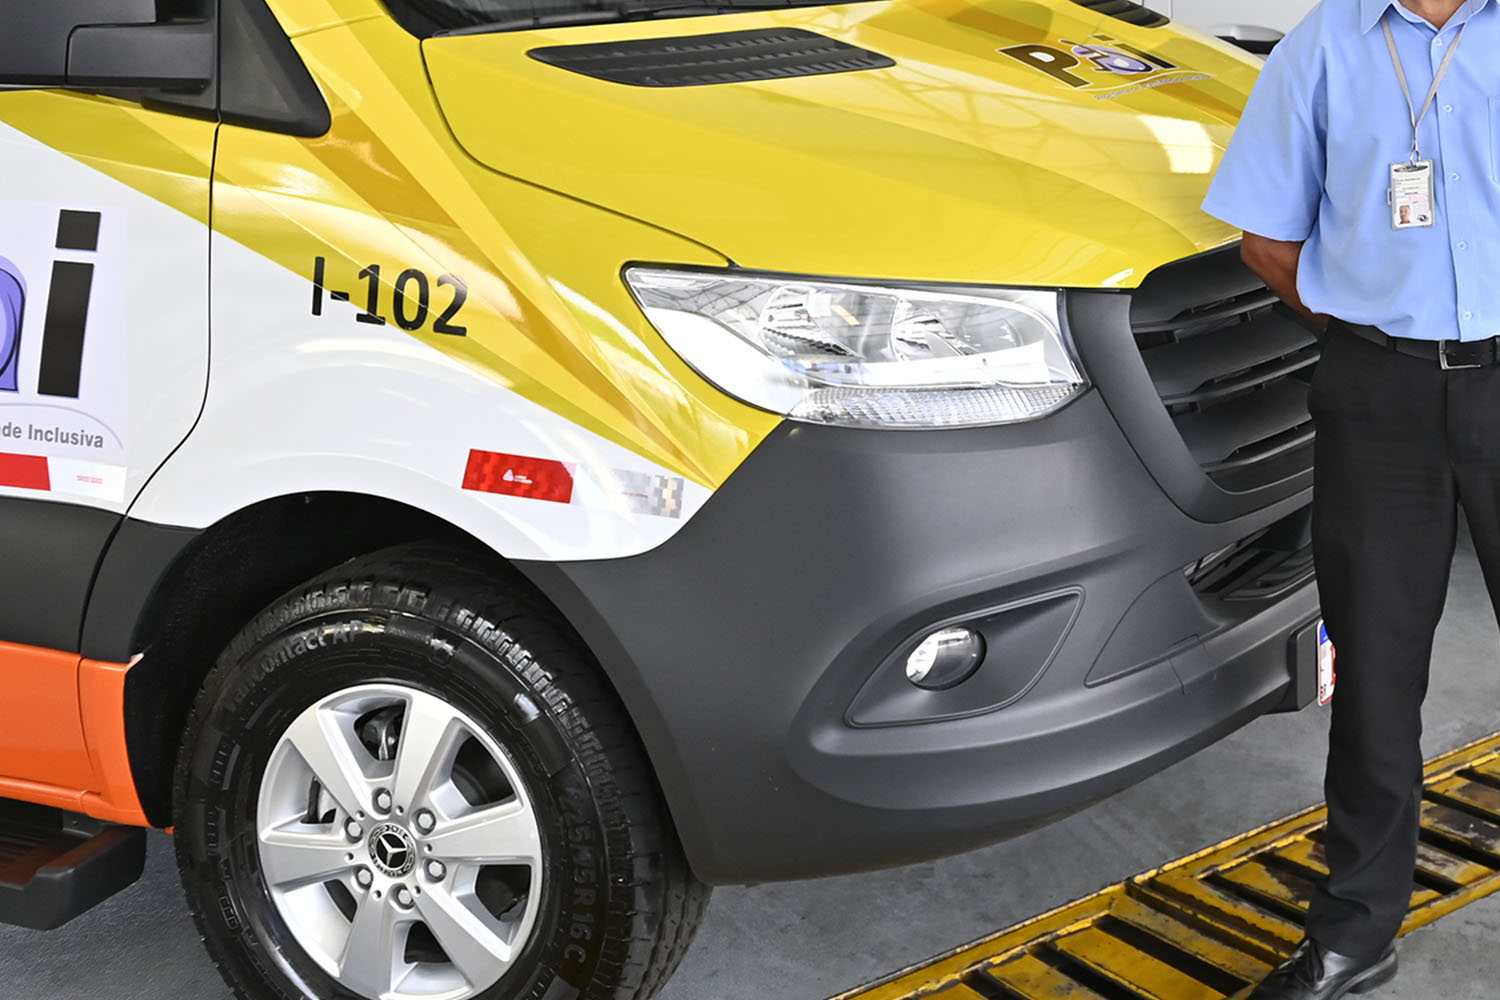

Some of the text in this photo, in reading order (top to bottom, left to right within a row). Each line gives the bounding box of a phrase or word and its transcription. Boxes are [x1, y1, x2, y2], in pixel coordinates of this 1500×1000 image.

[311, 256, 468, 337] I-102
[0, 421, 104, 449] de Inclusiva
